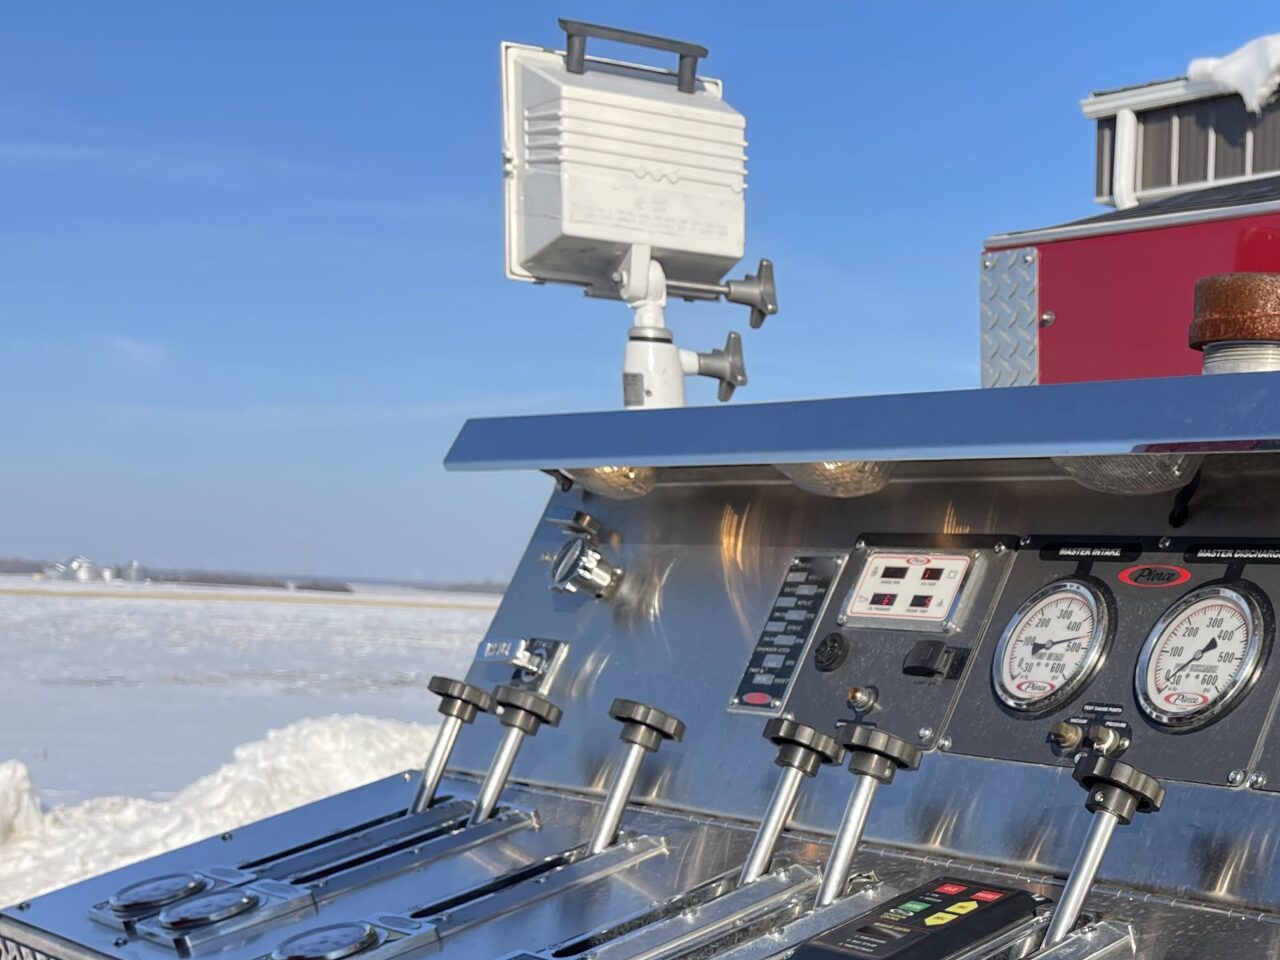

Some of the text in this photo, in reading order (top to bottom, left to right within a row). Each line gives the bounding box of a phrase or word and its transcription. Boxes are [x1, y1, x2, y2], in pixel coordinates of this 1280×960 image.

[1059, 548, 1121, 557] MASTER INTAKE
[1197, 549, 1233, 558] MASTER
[1134, 567, 1174, 583] Pierce
[1057, 609, 1074, 620] 300
[1035, 617, 1051, 628] 200
[1066, 621, 1082, 632] 400
[1206, 617, 1224, 629] 300
[1182, 626, 1200, 637] 200
[1217, 630, 1235, 641] 400
[1023, 636, 1037, 646] 100
[1066, 641, 1082, 652] 500
[1169, 646, 1184, 657] 100
[1018, 658, 1024, 668] 0
[1217, 652, 1235, 663] 500
[1050, 662, 1066, 673] 600
[1201, 674, 1218, 686] 600
